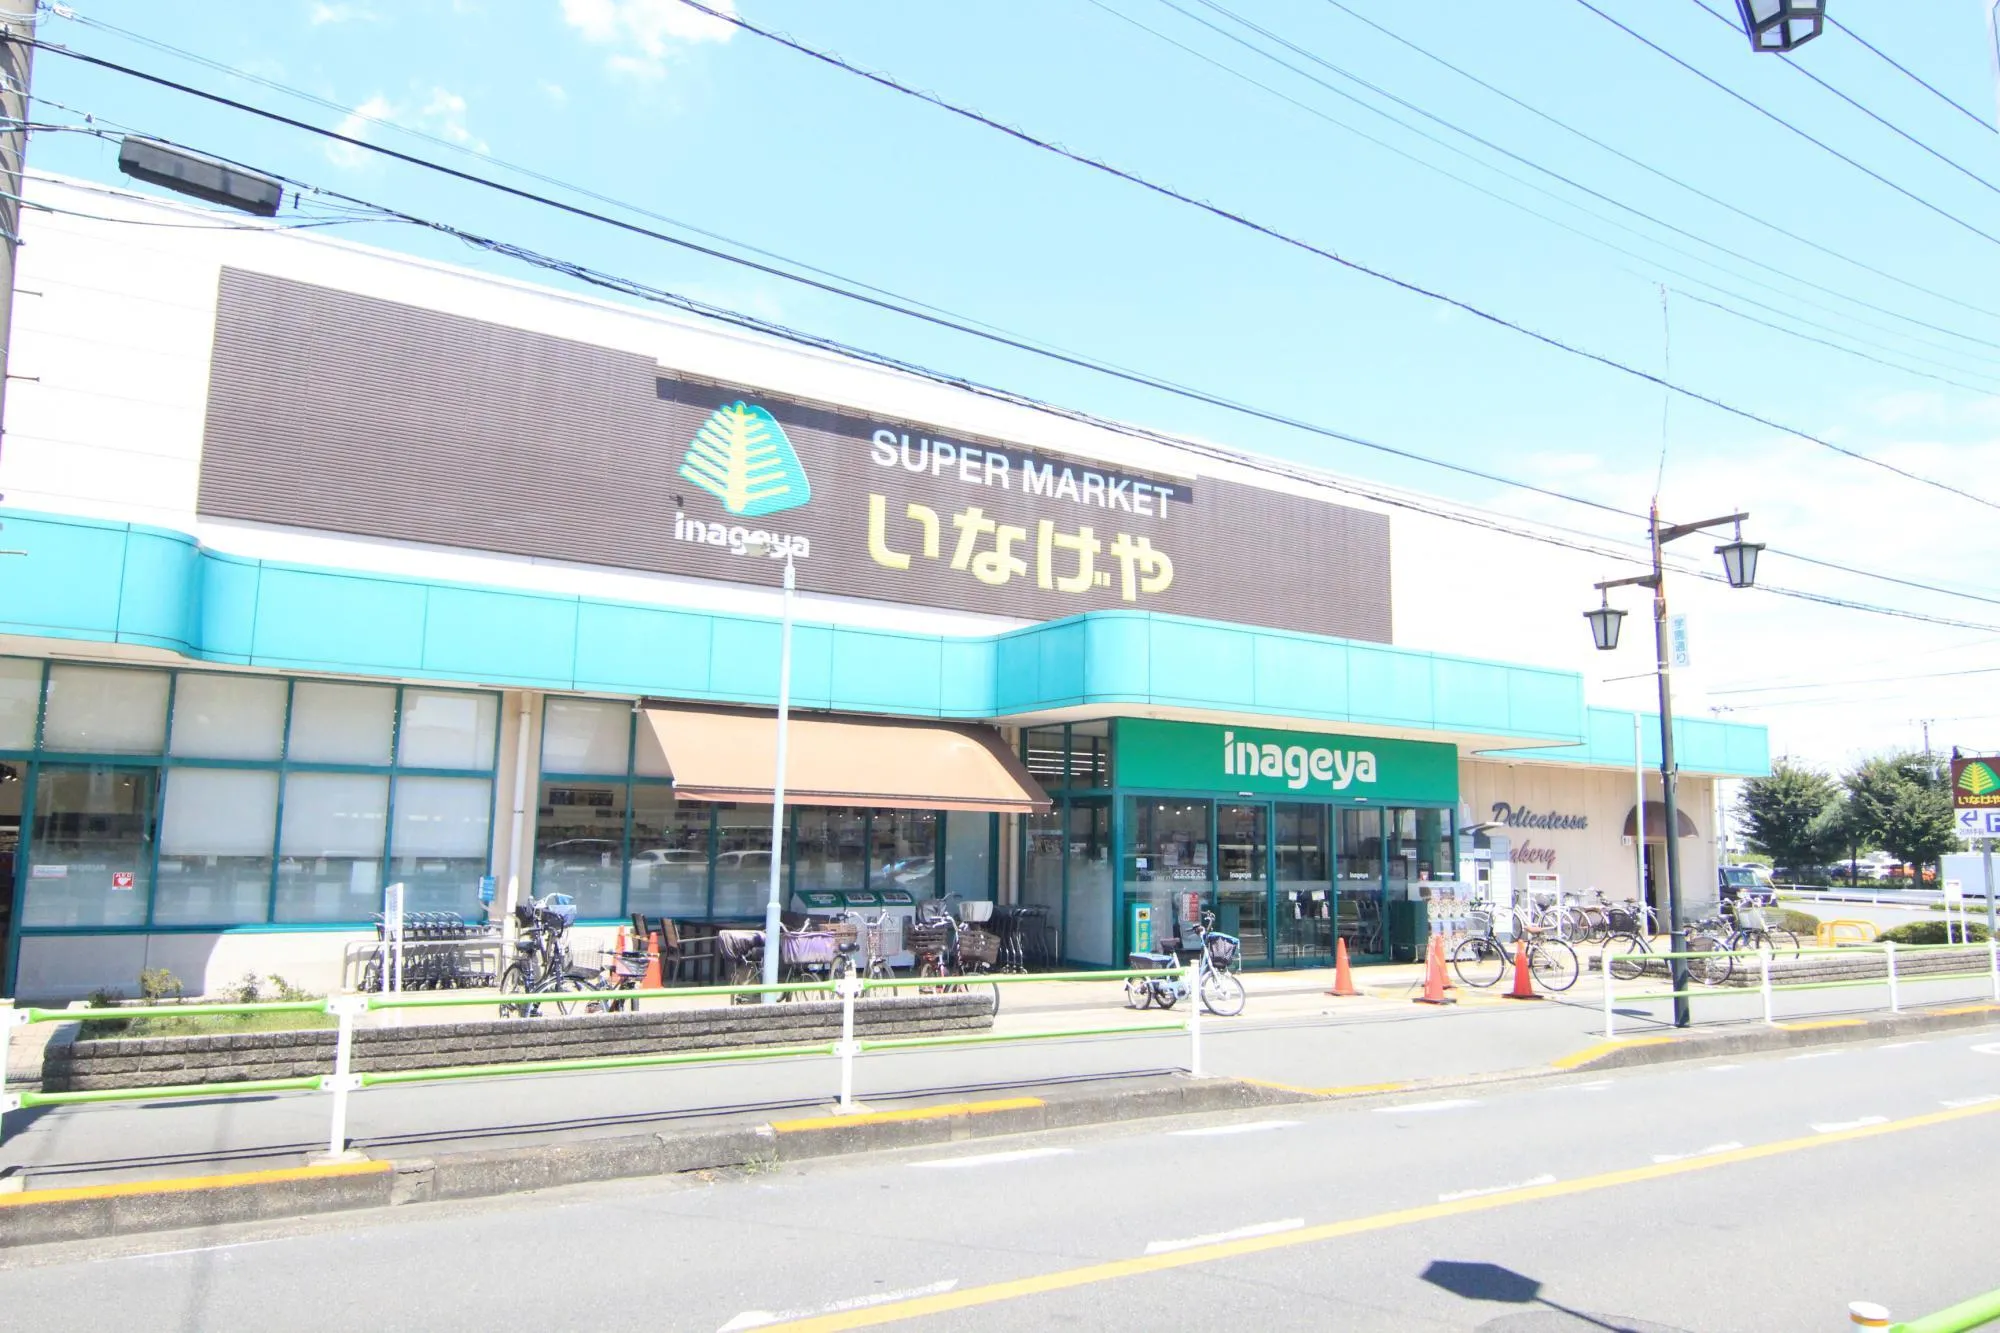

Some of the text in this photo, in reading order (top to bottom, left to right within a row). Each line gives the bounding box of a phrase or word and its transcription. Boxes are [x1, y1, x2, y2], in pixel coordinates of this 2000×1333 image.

[871, 429, 1174, 519] SUPER MARKET
[674, 511, 810, 558] inageya
[867, 493, 1174, 602] いなげや
[1224, 731, 1377, 790] inageya
[1510, 839, 1556, 870] akery
